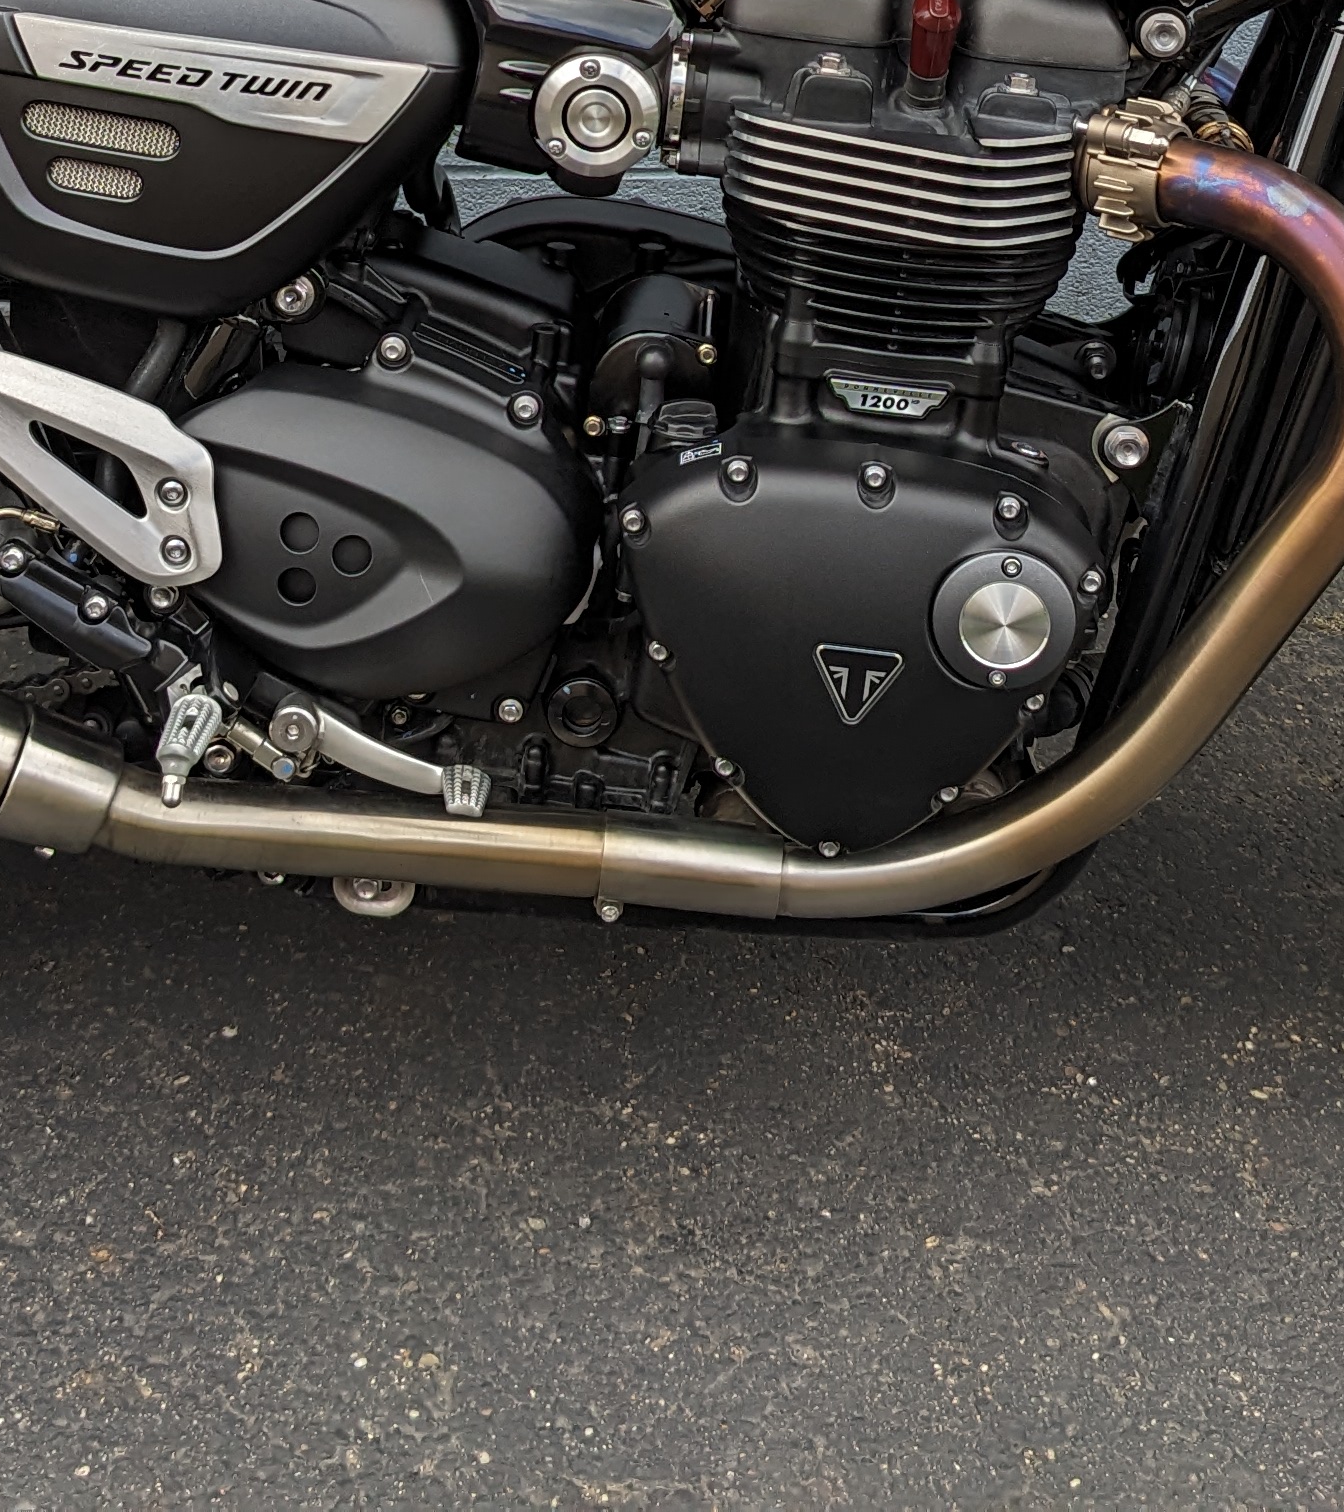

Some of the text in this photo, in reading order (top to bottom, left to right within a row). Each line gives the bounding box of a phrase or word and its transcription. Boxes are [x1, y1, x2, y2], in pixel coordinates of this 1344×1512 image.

[59, 50, 333, 102] SPEED TWIN
[843, 383, 934, 399] BONNEVILLE
[859, 393, 910, 411] 1200
